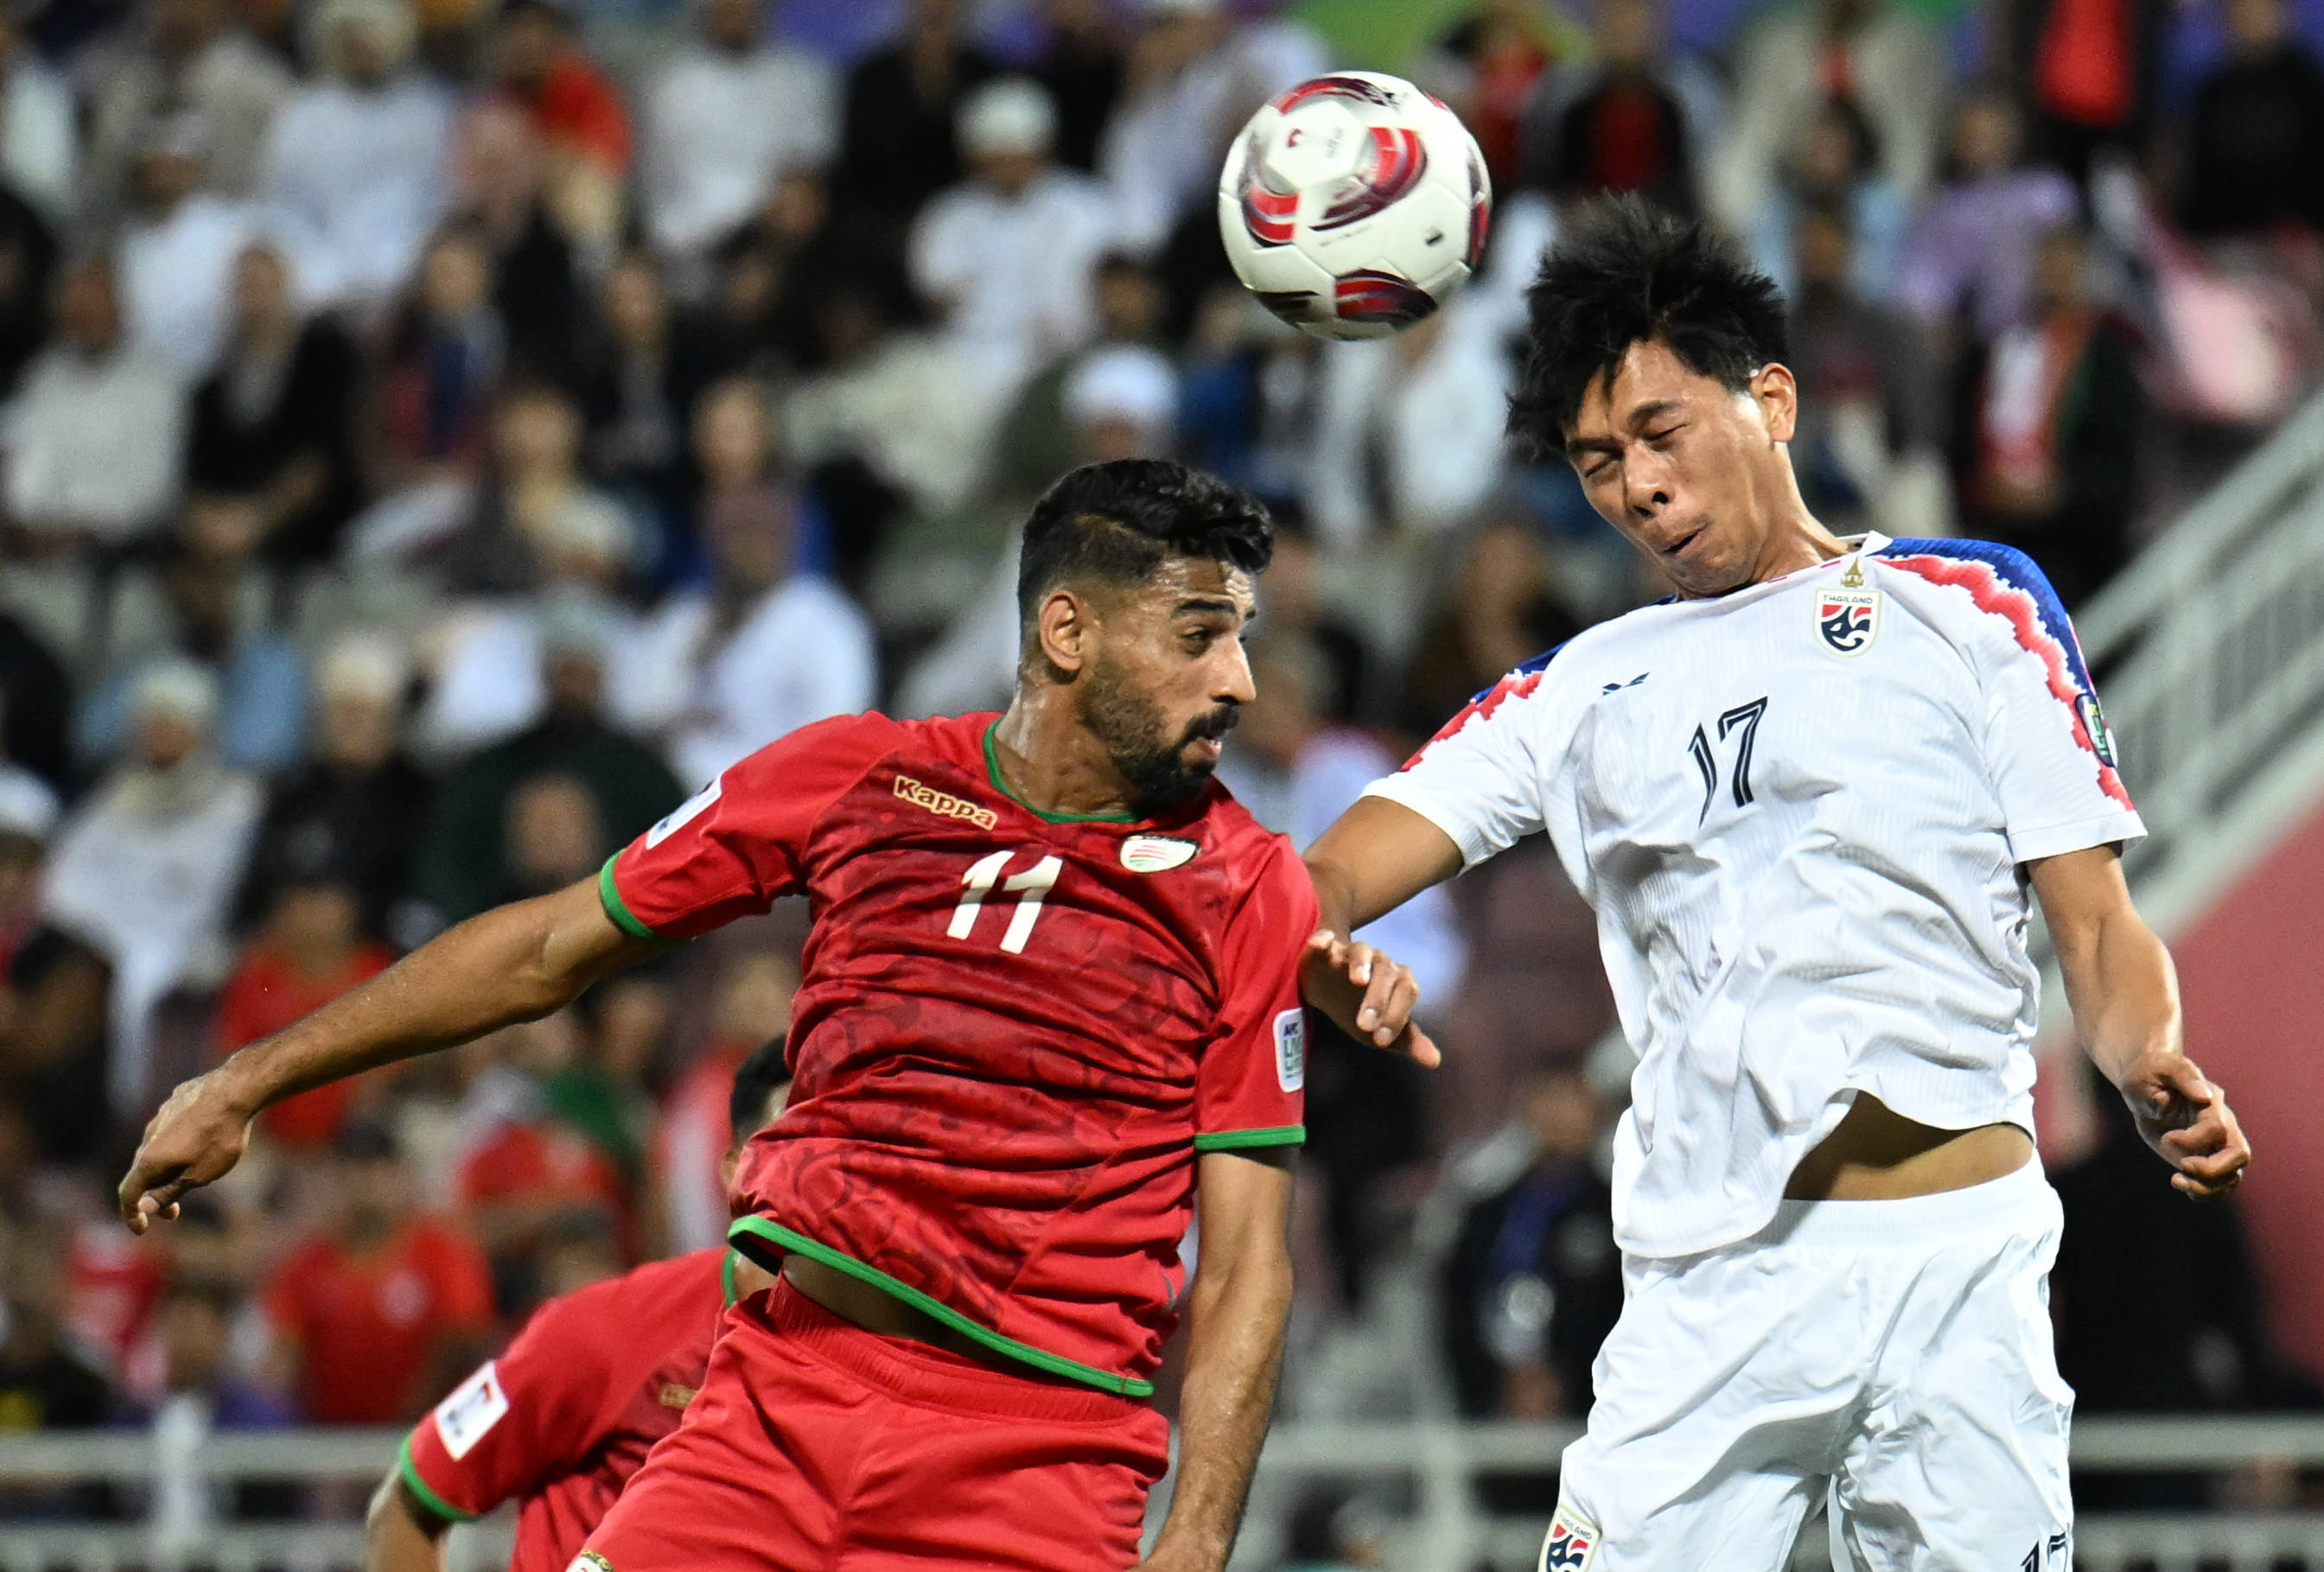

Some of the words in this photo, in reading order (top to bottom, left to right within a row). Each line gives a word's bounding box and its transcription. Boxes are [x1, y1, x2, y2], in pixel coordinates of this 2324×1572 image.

[1823, 595, 1873, 604] THAILAND
[894, 775, 997, 831] Kappa
[1687, 696, 1768, 830] 17
[946, 850, 1063, 954] 11
